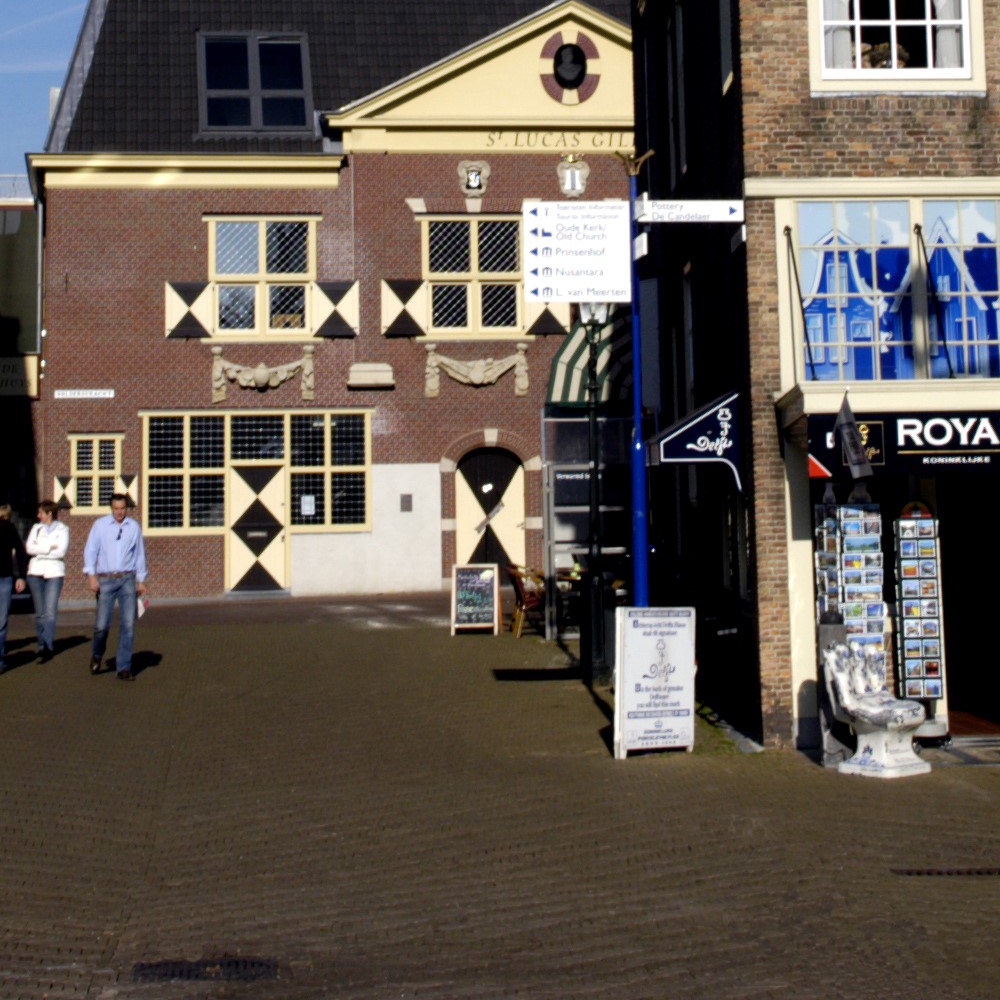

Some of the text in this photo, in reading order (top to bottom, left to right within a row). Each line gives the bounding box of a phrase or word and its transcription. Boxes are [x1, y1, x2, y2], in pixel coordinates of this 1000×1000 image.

[514, 131, 581, 147] LUCAS
[591, 131, 635, 147] GIL
[652, 202, 684, 212] Pottery
[652, 212, 665, 221] De
[556, 224, 580, 233] Oude
[556, 232, 607, 241] Old Church
[556, 248, 605, 256] Prinsenhof
[556, 268, 604, 276] Nusantara
[586, 288, 627, 296] Meerten
